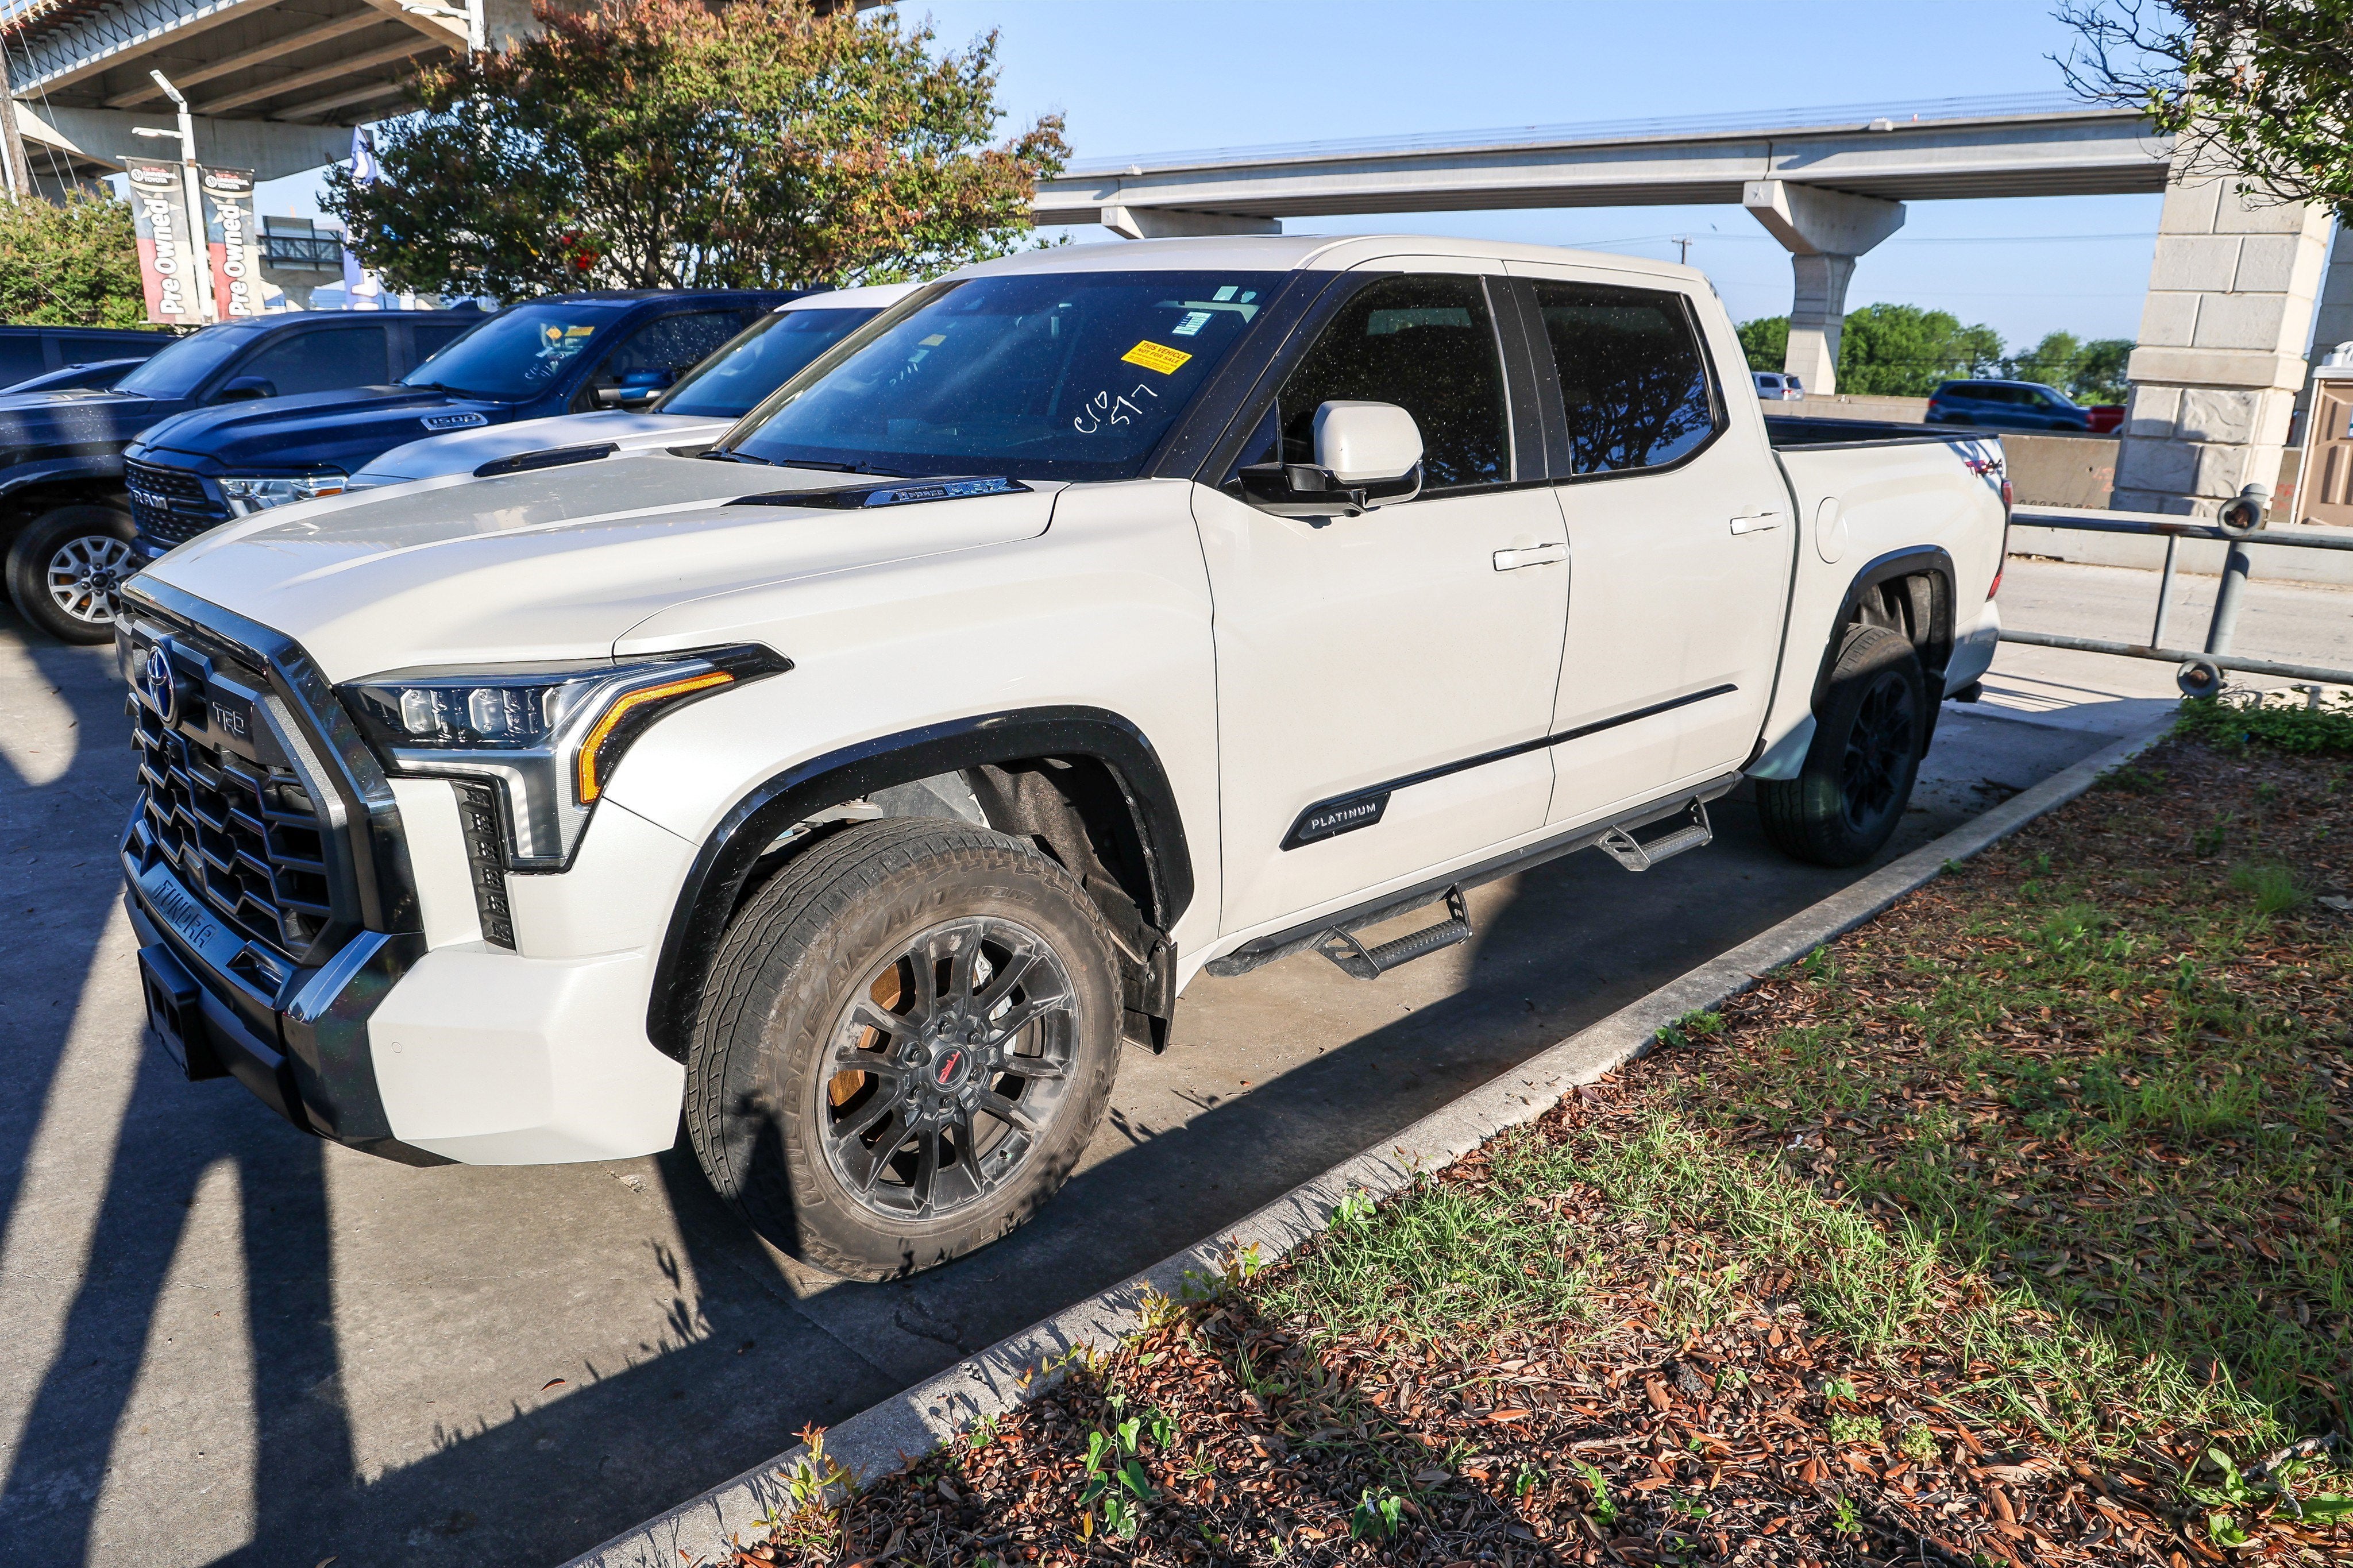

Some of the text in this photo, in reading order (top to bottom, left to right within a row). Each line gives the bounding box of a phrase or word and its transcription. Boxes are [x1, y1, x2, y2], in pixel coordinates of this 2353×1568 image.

[143, 199, 178, 275] Owned
[216, 203, 246, 277] Owned
[159, 277, 186, 314] Pre
[228, 280, 252, 316] Pre
[1140, 342, 1189, 360] THIS VEHICLE
[1163, 355, 1181, 364] SALE
[431, 415, 477, 424] 1500
[132, 488, 168, 510] RAM
[943, 478, 1012, 496] MAX
[213, 701, 245, 737] TRD
[1311, 803, 1376, 829] PLATINUM
[153, 879, 217, 948] TUNDRA
[938, 1050, 961, 1084] TRD
